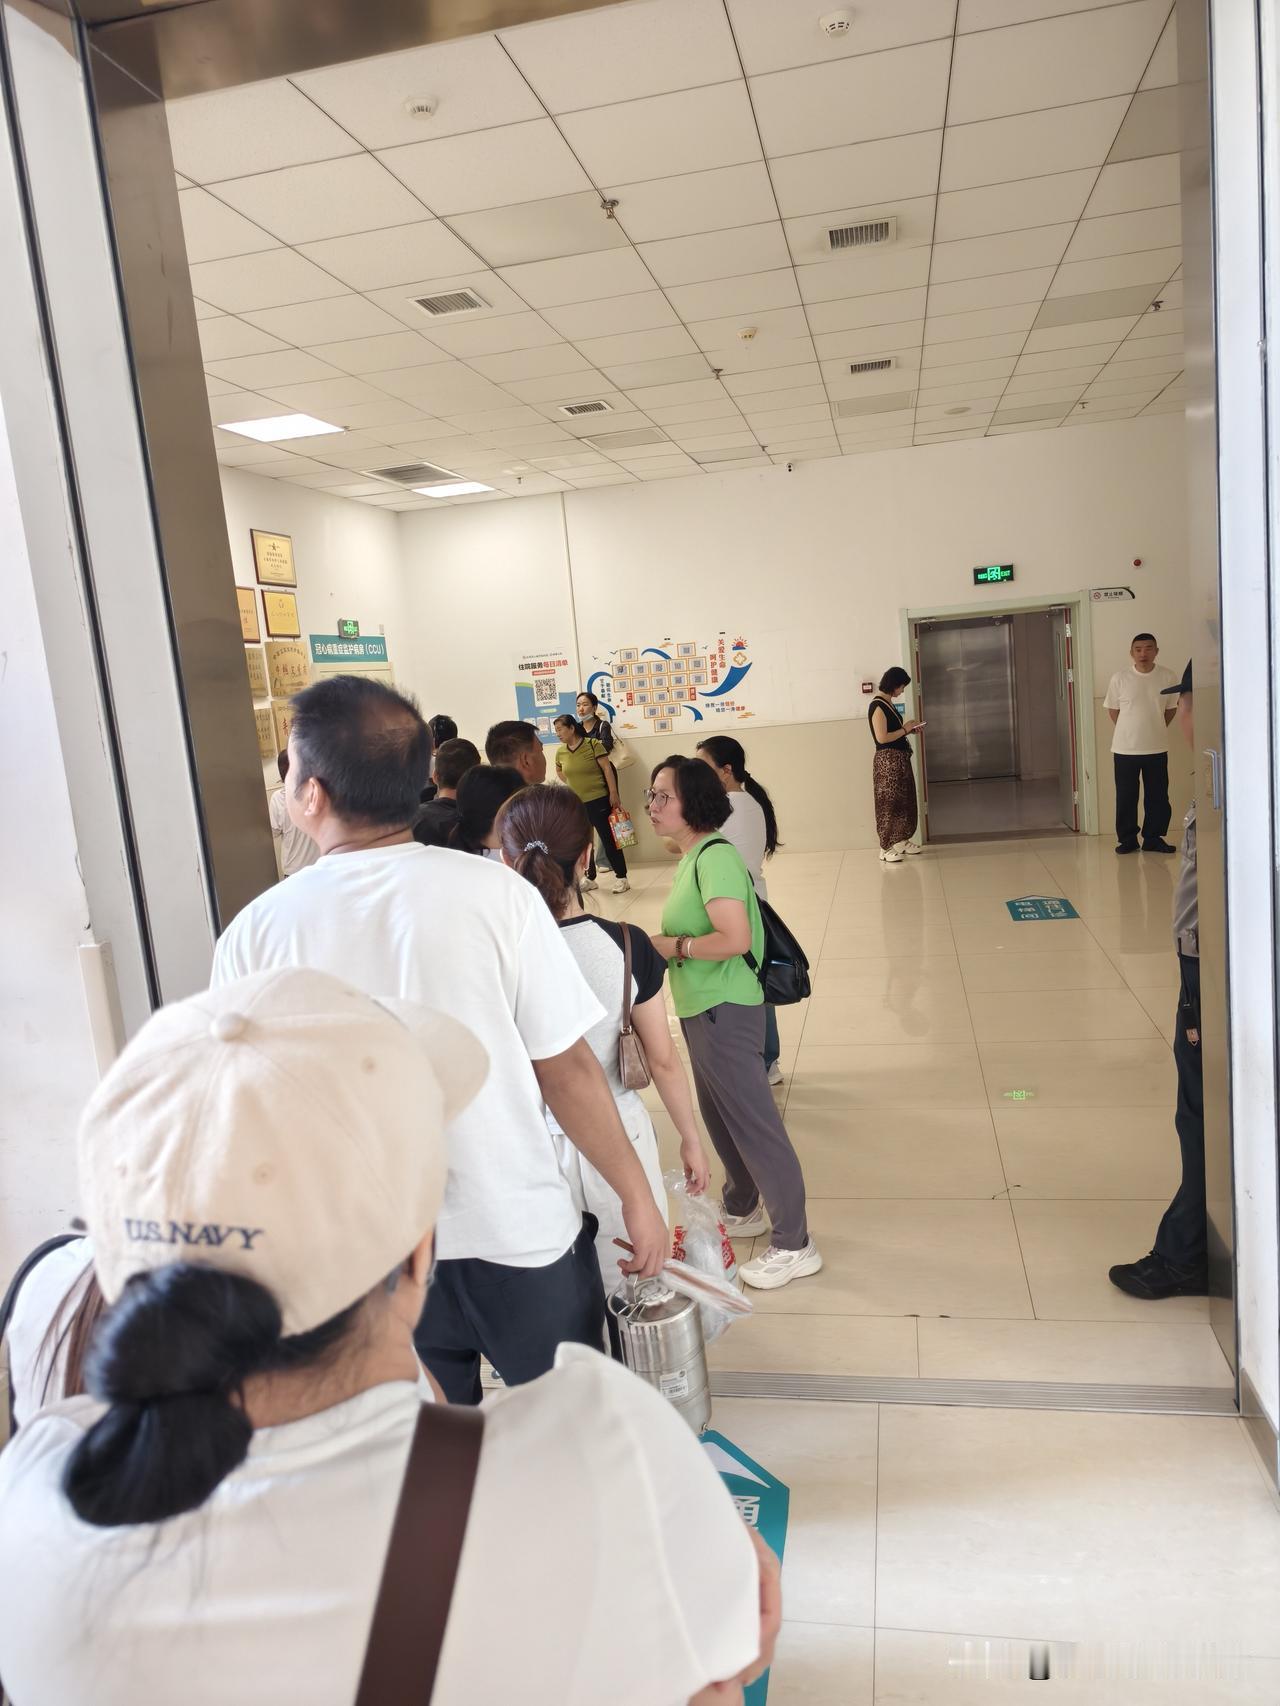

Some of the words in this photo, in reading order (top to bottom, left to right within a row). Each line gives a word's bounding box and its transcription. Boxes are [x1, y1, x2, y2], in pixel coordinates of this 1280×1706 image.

[518, 659, 569, 671] 住院服务每日清单
